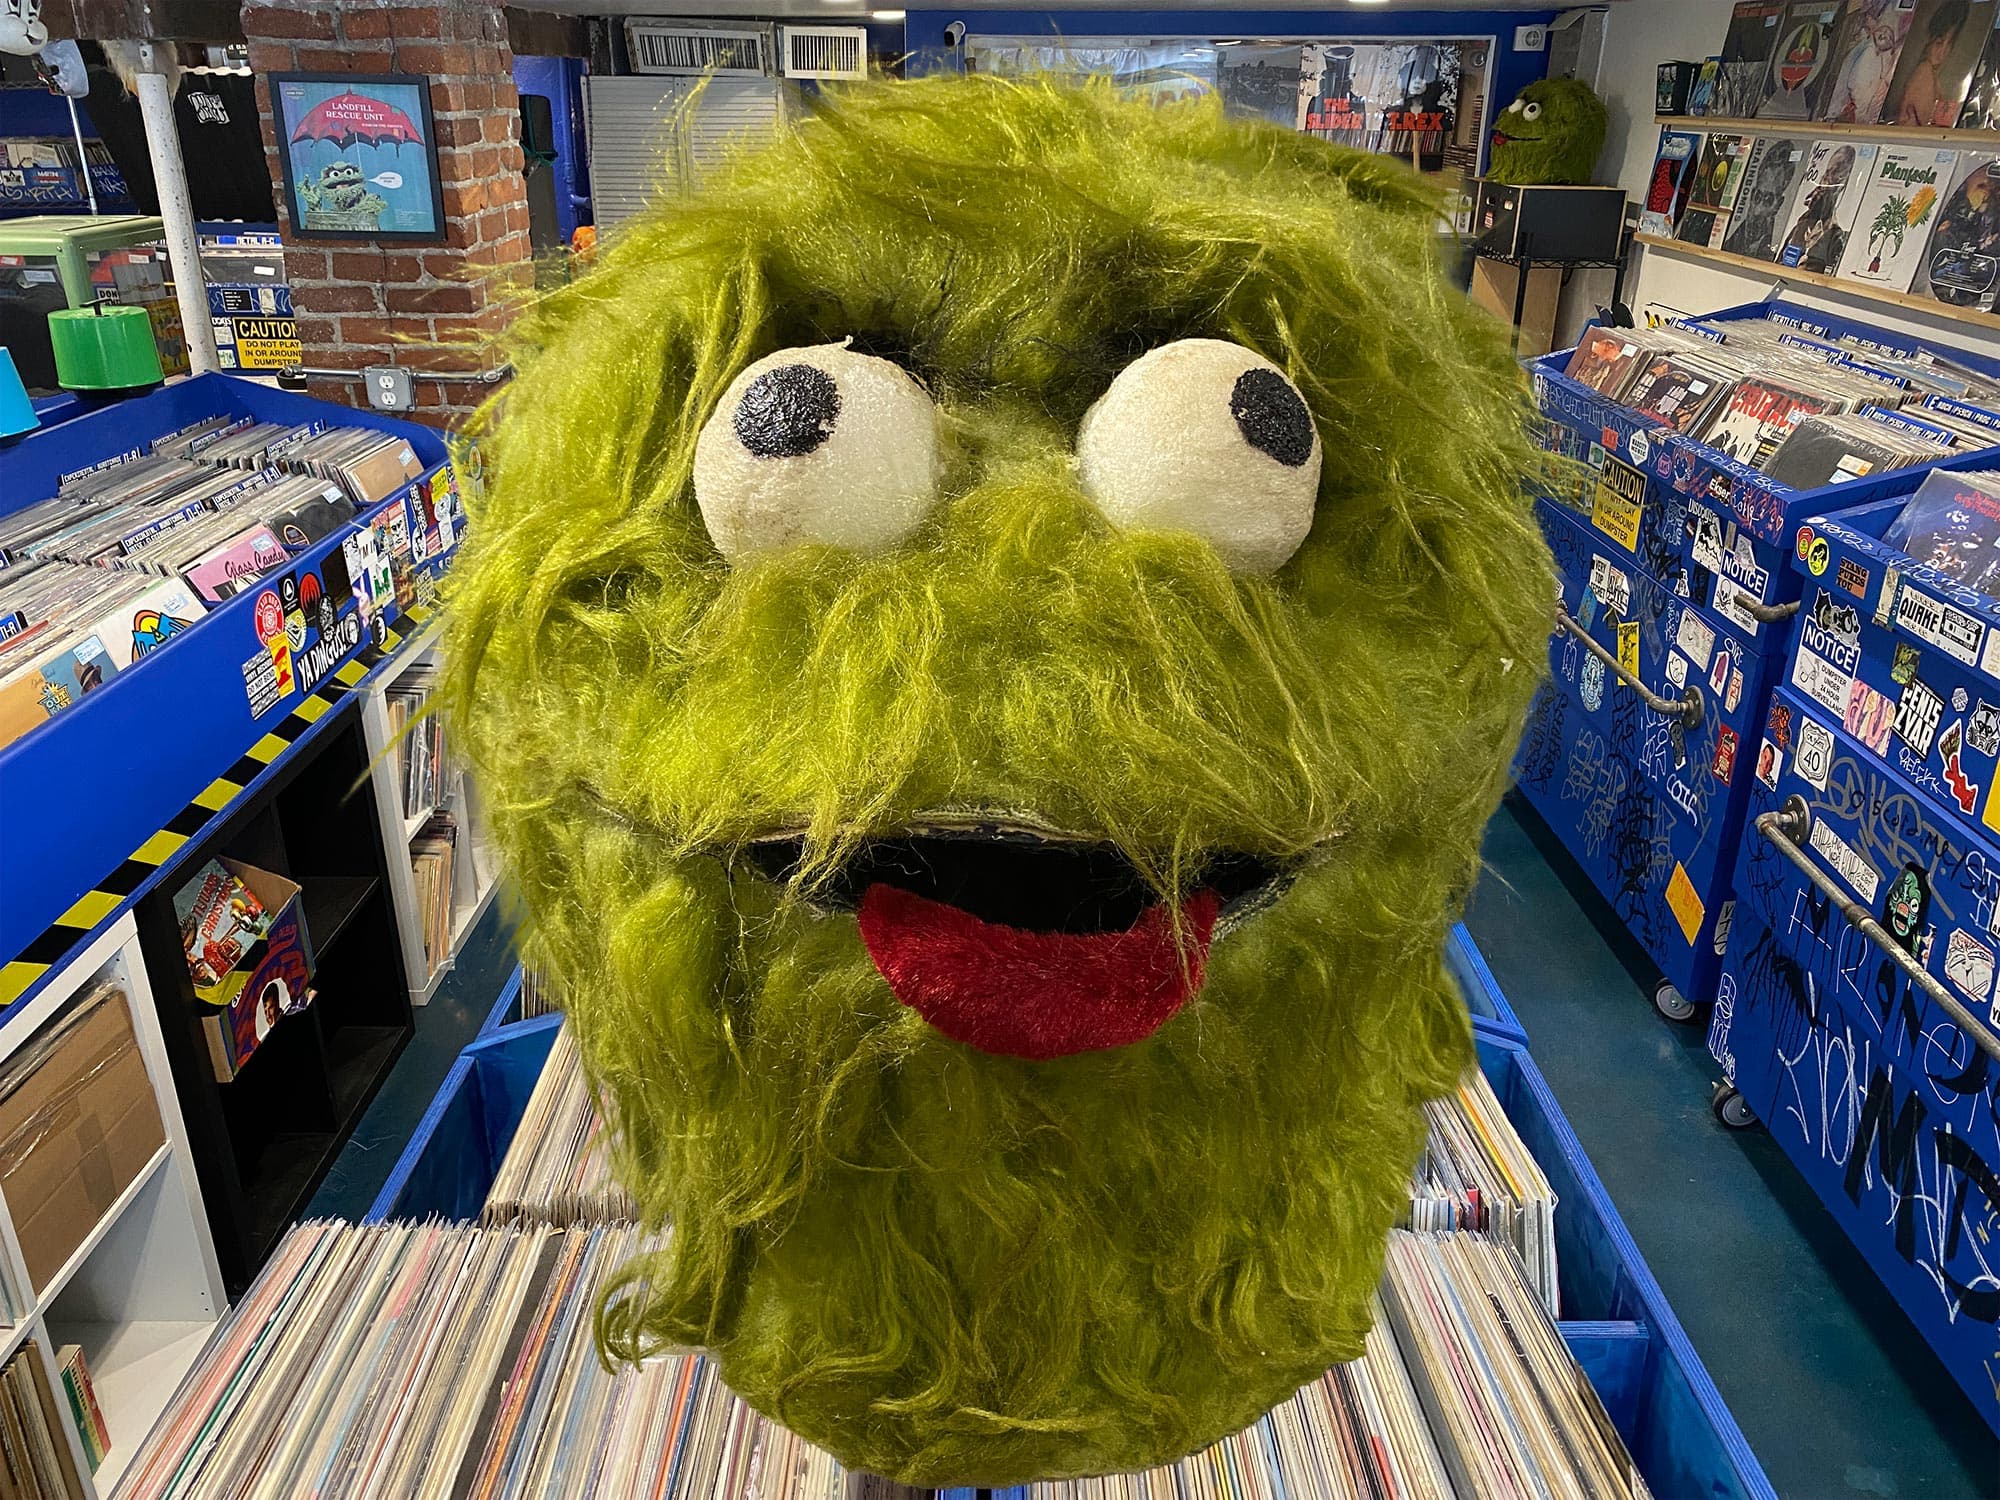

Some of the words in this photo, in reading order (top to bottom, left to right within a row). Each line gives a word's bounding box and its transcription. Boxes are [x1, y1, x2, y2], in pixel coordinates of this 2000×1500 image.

[326, 110, 362, 120] RESCUE
[363, 112, 384, 121] UNIT
[331, 102, 374, 112] LANDFILL
[1325, 98, 1350, 112] THE
[1307, 113, 1363, 130] SLIDER
[1388, 112, 1443, 131] T.REX
[1880, 161, 1937, 188] Plantasia
[1602, 460, 1643, 504] CAUTION
[1600, 516, 1628, 544] DUMPSTER
[1604, 506, 1612, 515] OR
[1612, 510, 1635, 533] AROUND
[225, 561, 255, 585] Glass
[254, 549, 285, 572] Candy
[1594, 559, 1607, 574] VERY
[1723, 555, 1765, 594] NOTICE
[1840, 558, 1868, 578] STANG
[1595, 573, 1604, 585] TOP
[1837, 576, 1854, 591] YOU
[1839, 567, 1866, 588] PUKES
[1900, 597, 1940, 633] QUAKE
[297, 657, 313, 692] YA
[311, 621, 347, 682] DINGUS!
[1805, 625, 1855, 672] NOTICE
[255, 677, 264, 690] NOT
[1822, 664, 1847, 687] DUMPSTER
[1824, 675, 1841, 693] UNDER
[1811, 687, 1846, 718] SURVEILLANCE
[1820, 684, 1827, 694] 24
[1827, 688, 1840, 702] HOUR
[1803, 749, 1821, 772] 40
